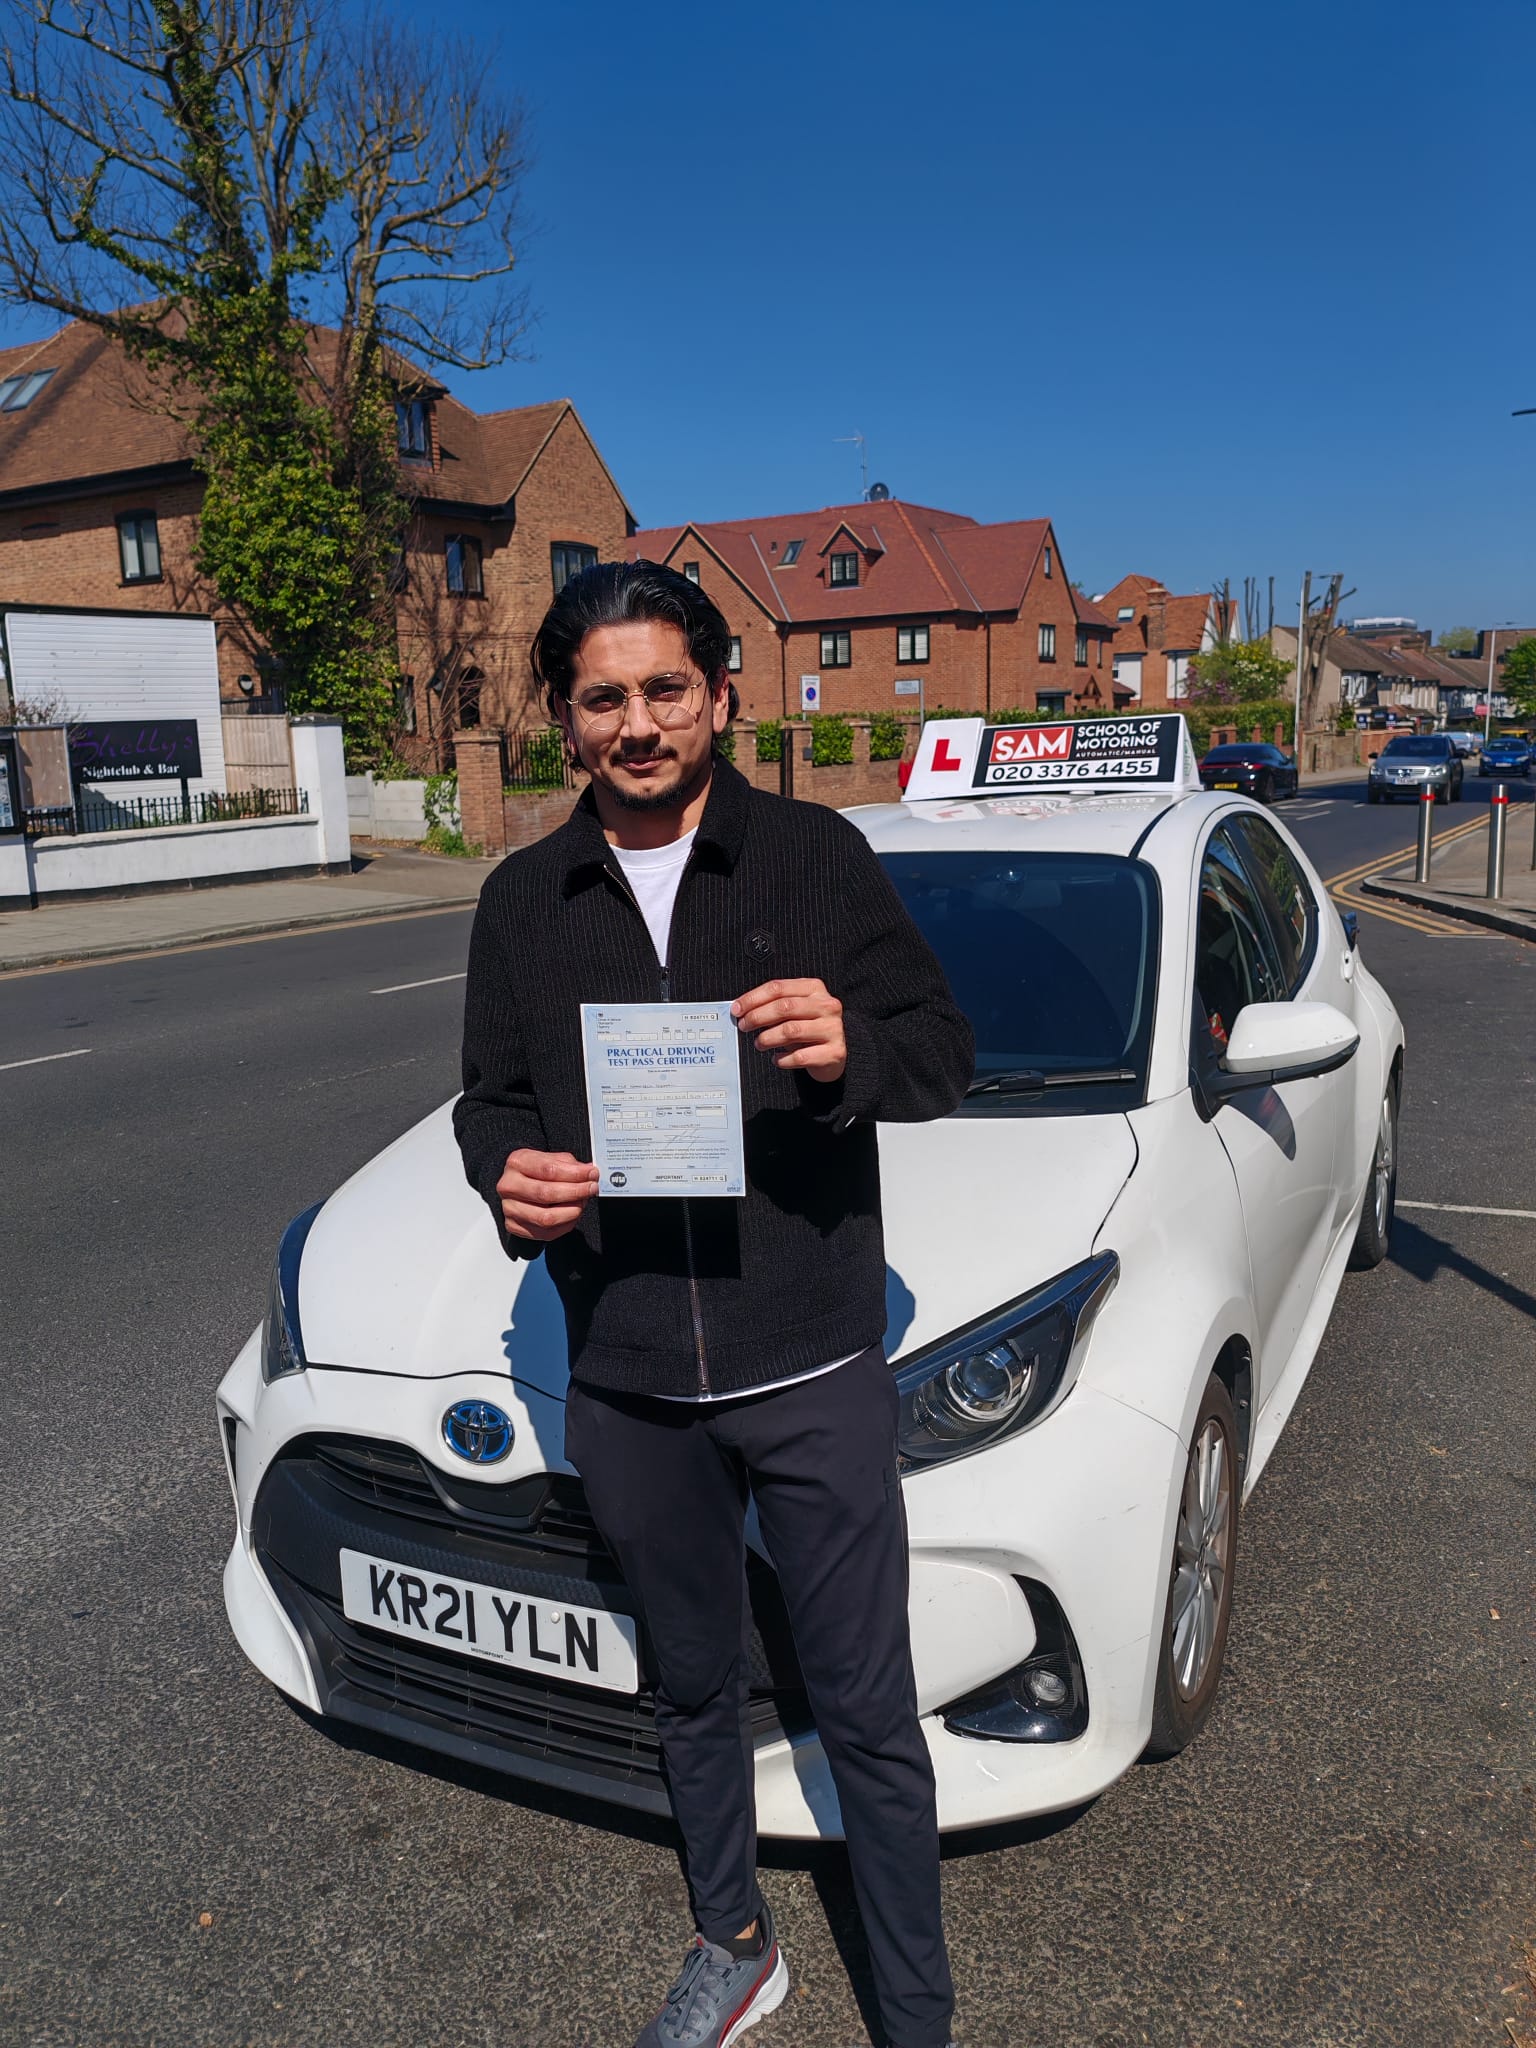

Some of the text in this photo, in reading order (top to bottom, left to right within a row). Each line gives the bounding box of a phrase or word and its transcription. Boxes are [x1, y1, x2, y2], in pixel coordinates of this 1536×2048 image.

[1077, 721, 1161, 738] SCHOOL OF
[73, 727, 193, 766] Shelly's
[995, 728, 1068, 761] SAM
[1075, 735, 1158, 750] MOTORING
[931, 739, 961, 771] L
[1075, 749, 1156, 758] AUTOMATIC/MANUAL
[82, 763, 180, 779] Nightclub & Bar
[992, 760, 1152, 781] 020 3376 4455
[607, 1046, 715, 1057] PRACTICAL DRIVING
[608, 1056, 716, 1067] TEST PASS CERTIFICATE
[369, 1564, 599, 1672] KR21 YLN
